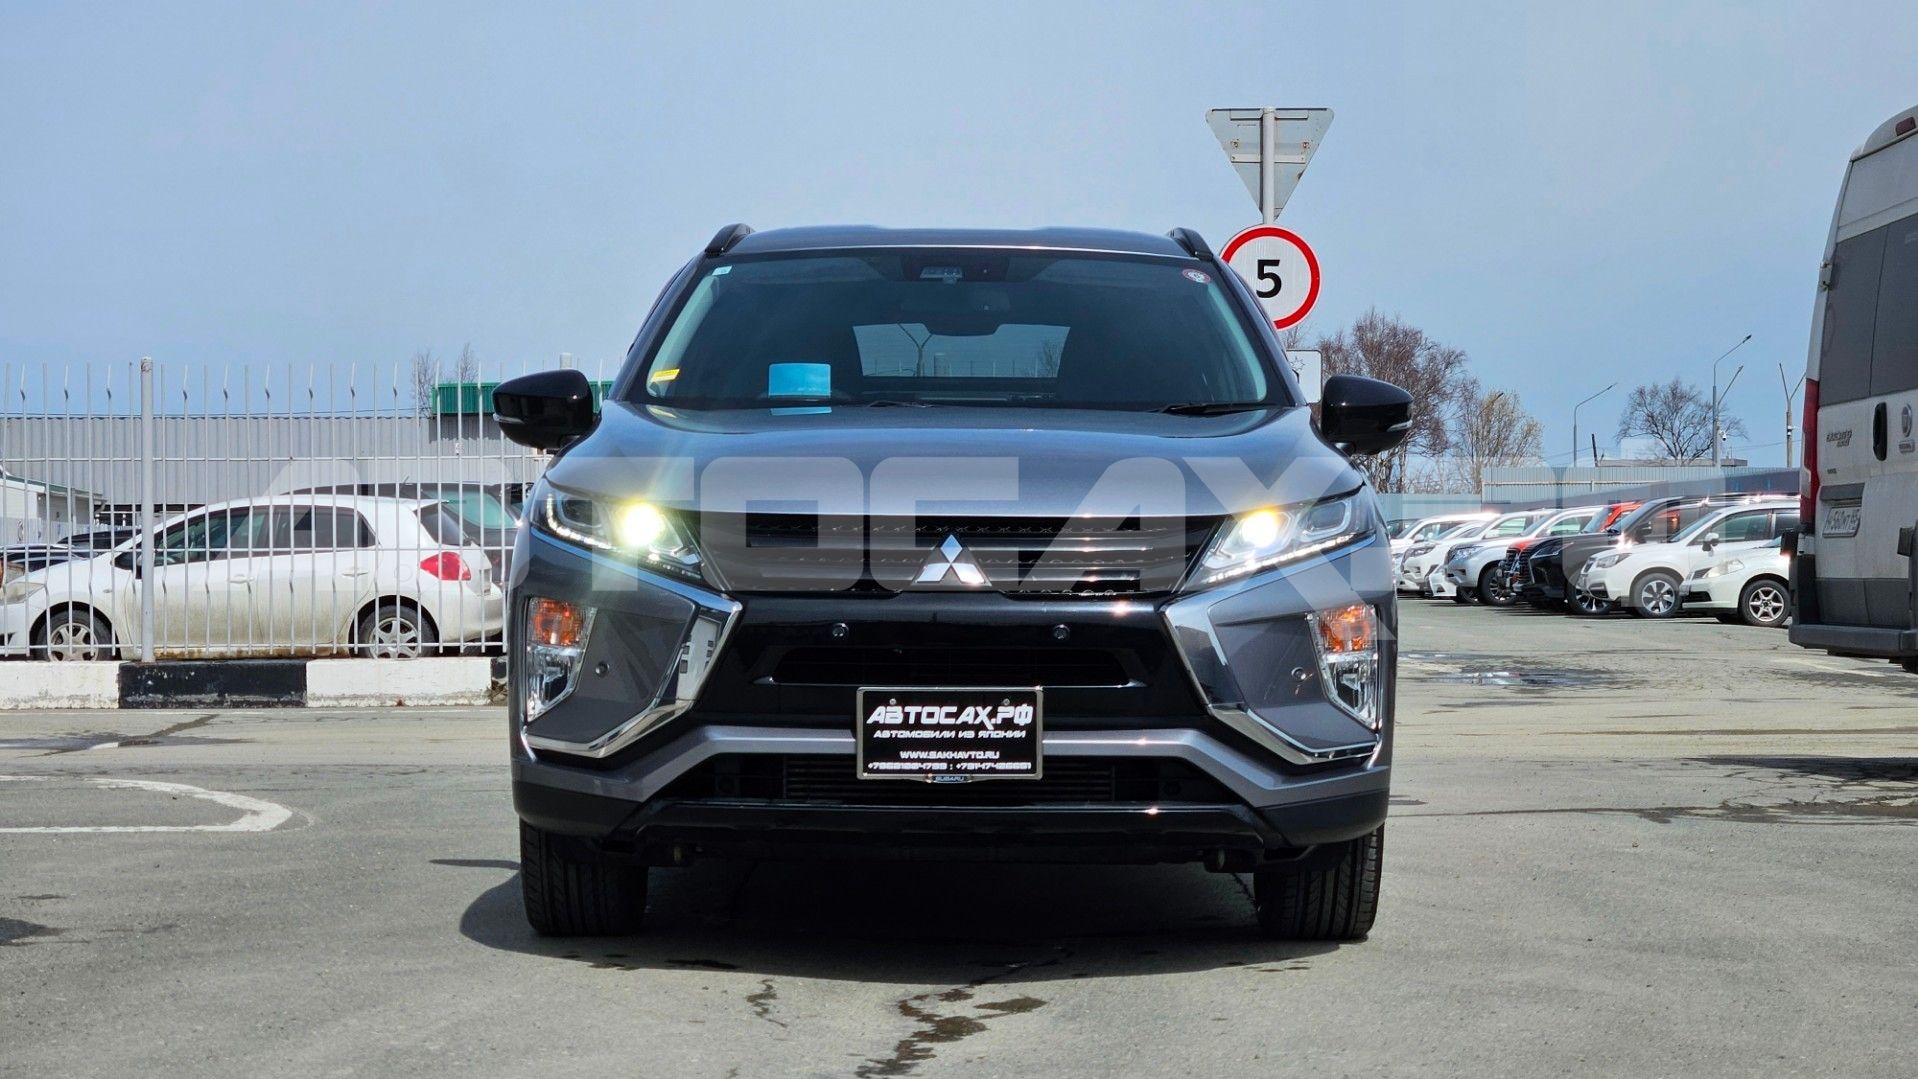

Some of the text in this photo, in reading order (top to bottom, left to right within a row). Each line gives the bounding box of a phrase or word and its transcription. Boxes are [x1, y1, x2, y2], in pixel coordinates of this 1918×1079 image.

[1256, 259, 1282, 298] 5
[866, 704, 1034, 730] АВТОСАХ.РФ
[873, 730, 1026, 739] АВТОМОБИЛИ ИЗ ЯПОНИИ
